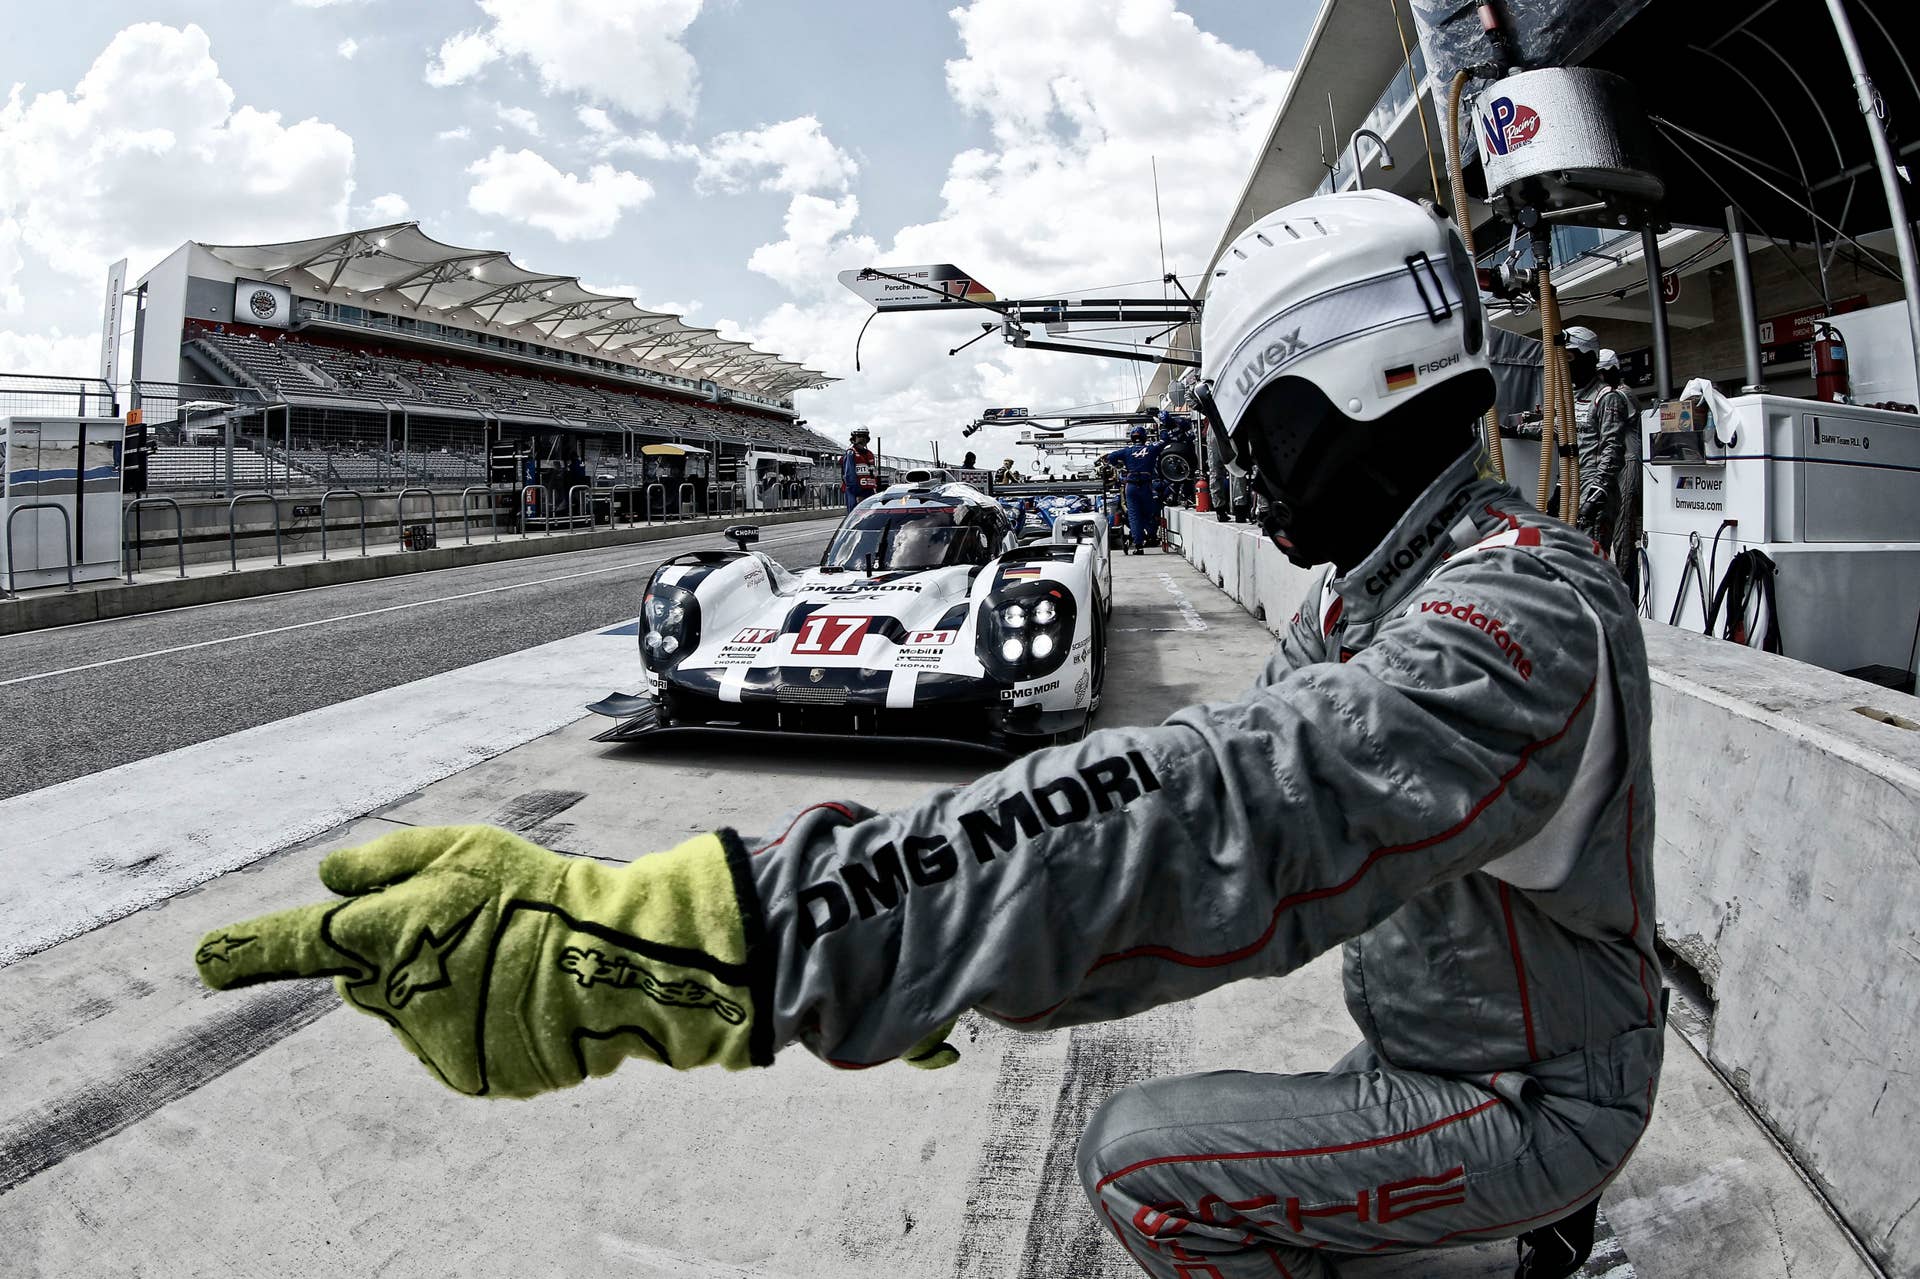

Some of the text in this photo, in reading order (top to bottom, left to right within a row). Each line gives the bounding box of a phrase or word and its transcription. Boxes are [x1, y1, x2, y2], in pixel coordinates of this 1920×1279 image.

[1483, 96, 1538, 155] VP Racing
[940, 280, 971, 302] 17
[1761, 326, 1771, 342] 17
[1235, 327, 1308, 396] uvex
[1418, 353, 1460, 376] FISCHI
[1012, 408, 1027, 416] 36
[1695, 476, 1722, 490] Power
[1676, 498, 1723, 511] bmwusa.com
[796, 617, 868, 652] 17
[914, 632, 948, 643] P1
[1421, 600, 1533, 682] vodafone
[1001, 680, 1060, 700] DMG MORI
[797, 750, 1163, 950] DMG MORI
